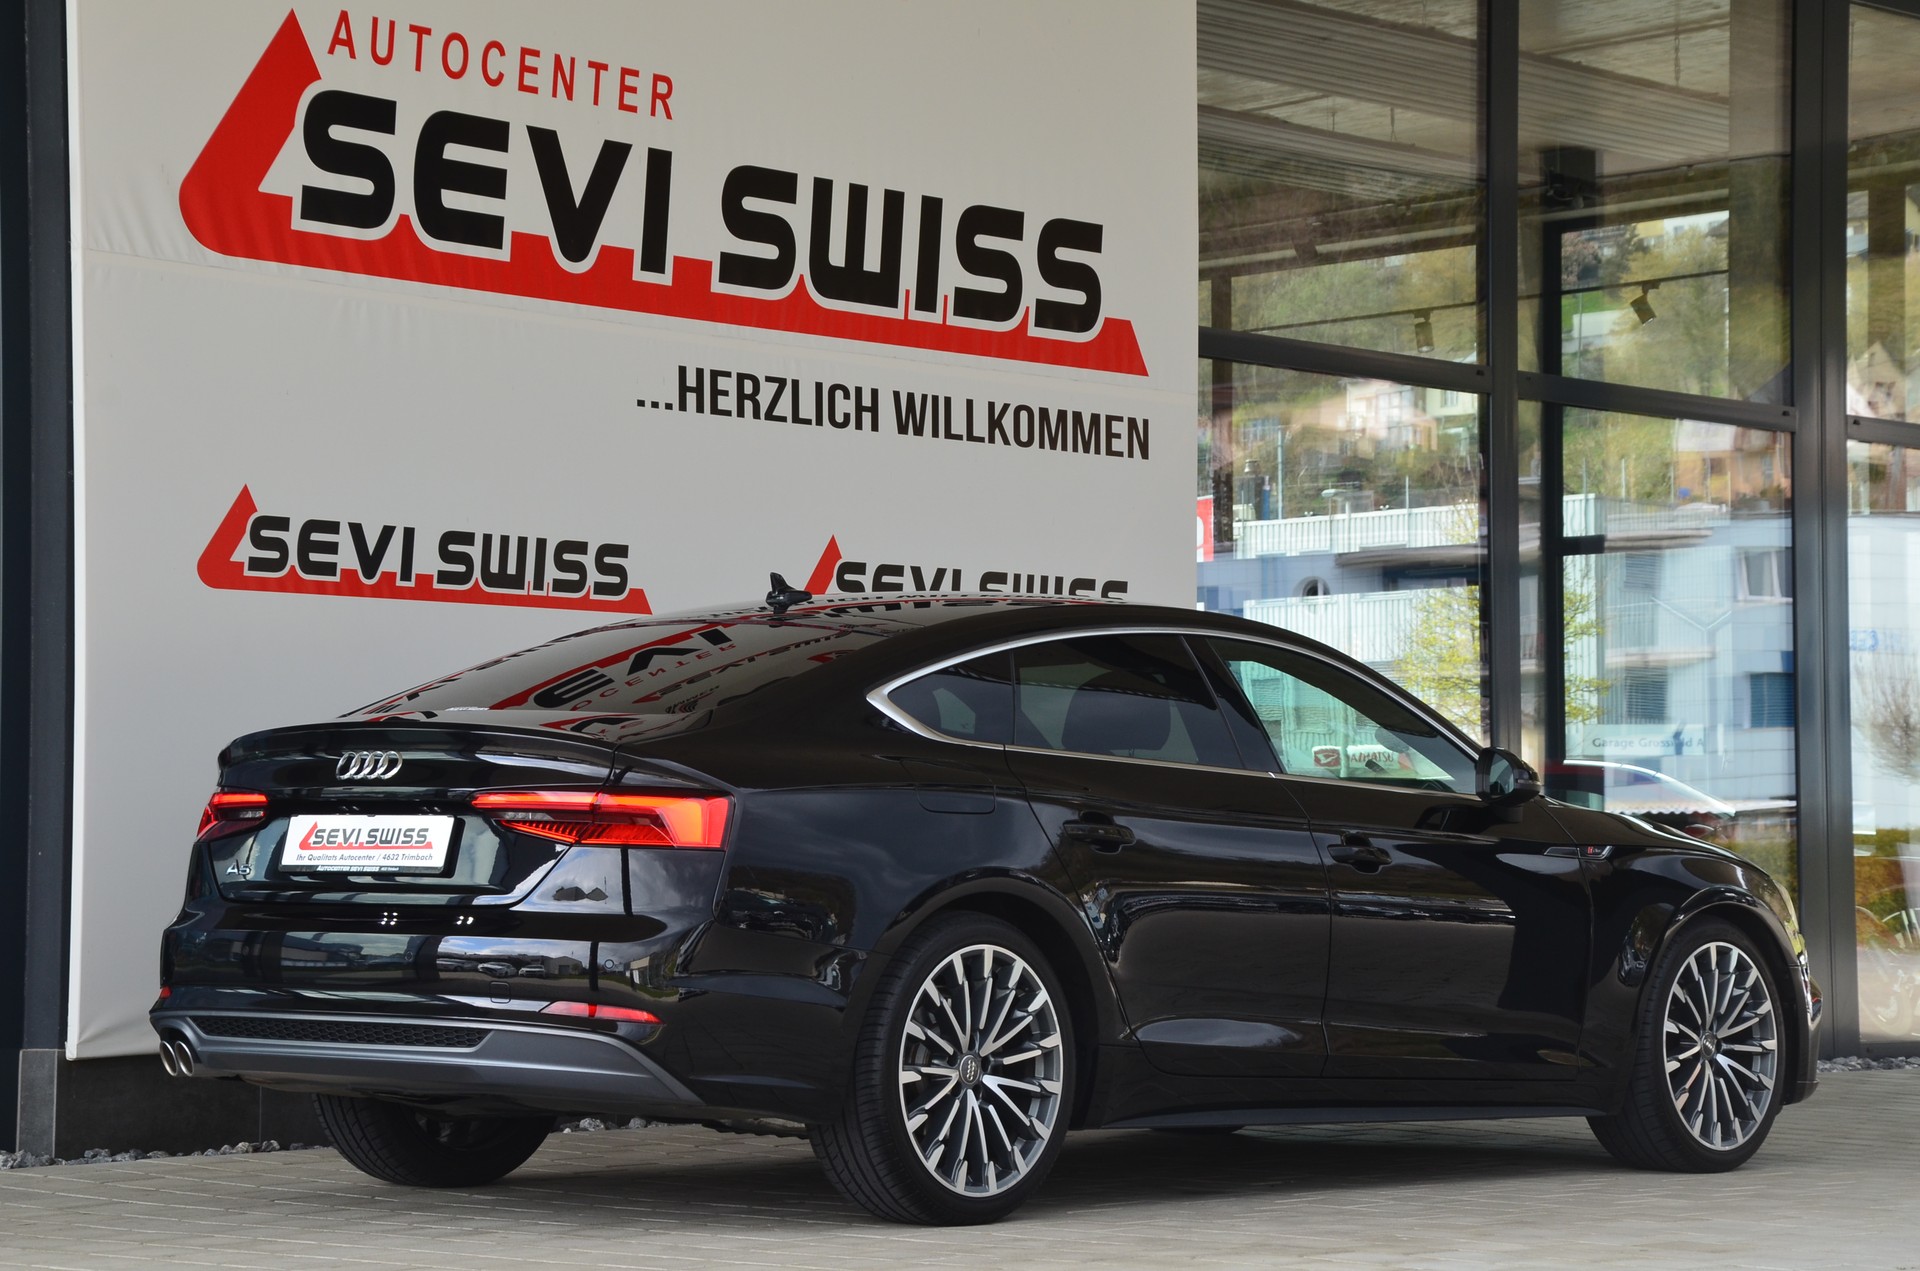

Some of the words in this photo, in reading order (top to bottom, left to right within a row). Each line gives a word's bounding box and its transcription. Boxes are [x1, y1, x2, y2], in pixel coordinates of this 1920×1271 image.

[328, 10, 673, 120] AUTOCENTER
[301, 89, 672, 274] SEVI
[719, 164, 1104, 334] SWISS
[637, 365, 879, 433] ...HERZLICH
[893, 390, 1149, 460] WILLKOMMEN
[247, 515, 416, 583] SEVI
[437, 530, 629, 597] SWISS
[226, 863, 250, 875] A5
[313, 828, 361, 845] SEVI
[366, 828, 429, 845] SWISS
